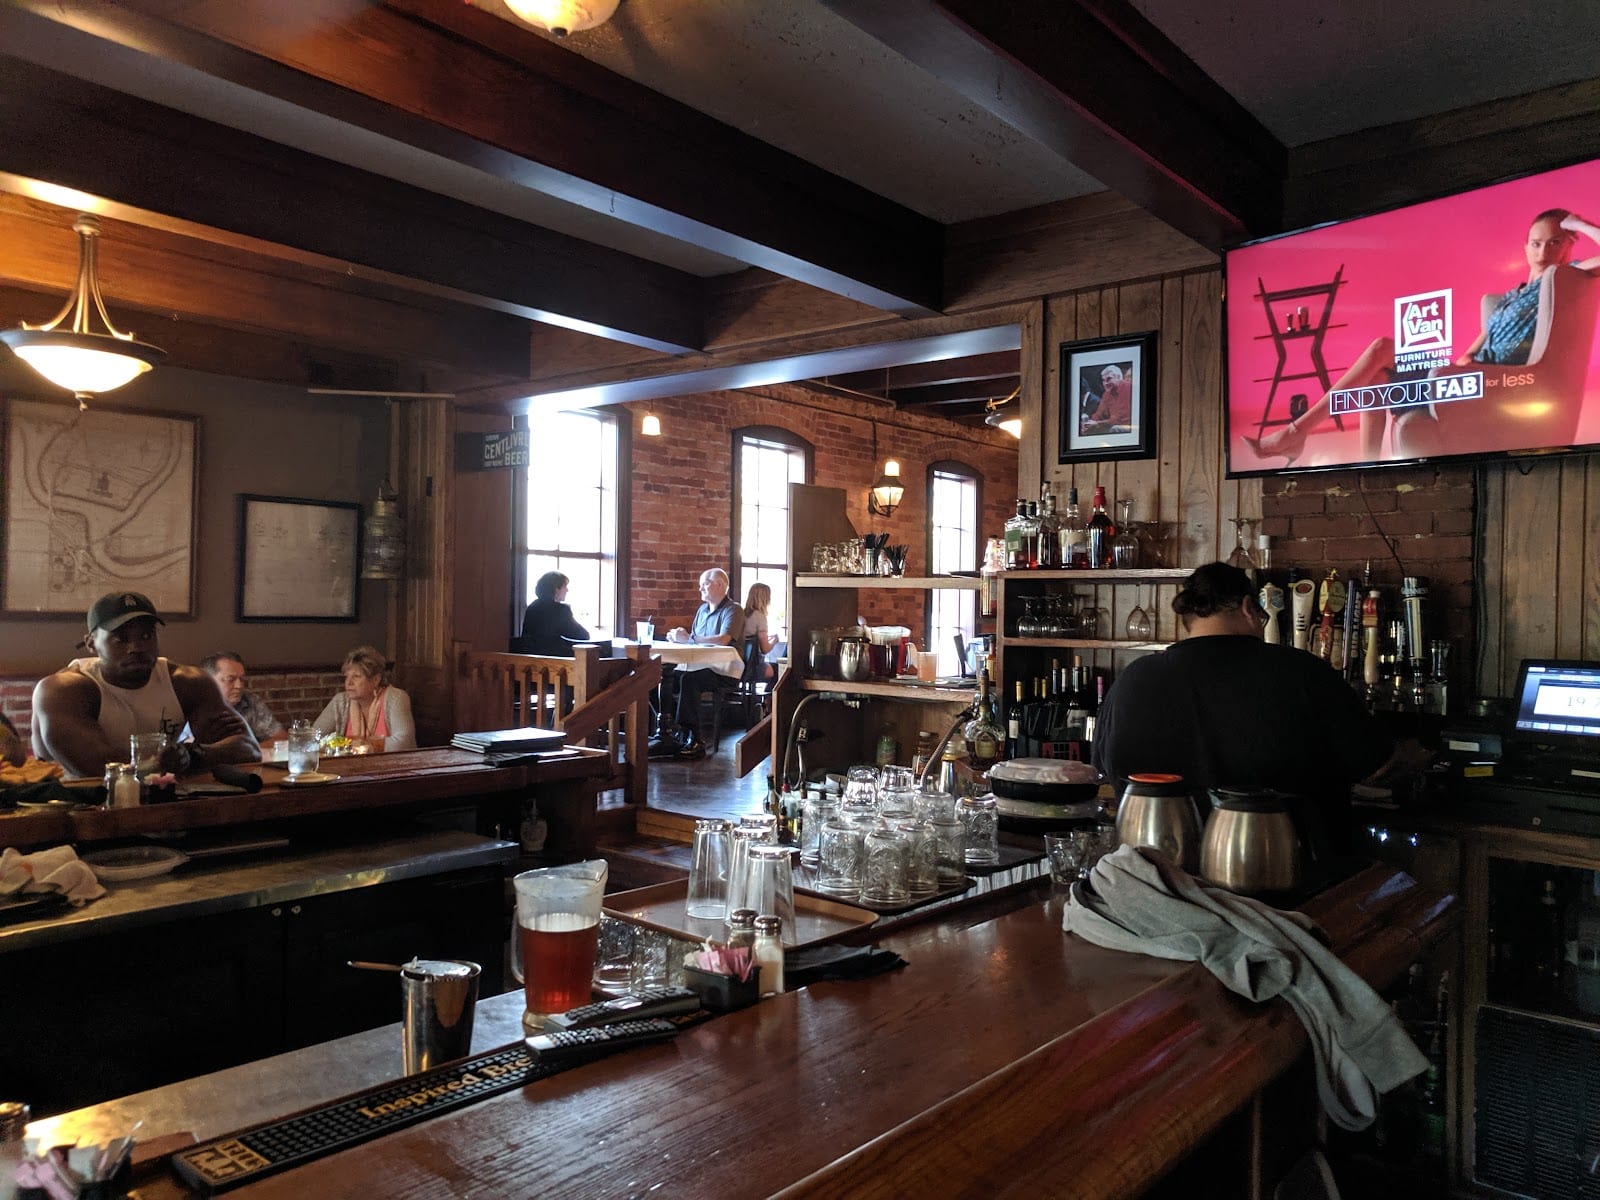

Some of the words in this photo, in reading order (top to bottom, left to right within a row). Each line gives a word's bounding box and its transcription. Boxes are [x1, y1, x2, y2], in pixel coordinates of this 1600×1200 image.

[1409, 301, 1438, 320] Art
[1409, 316, 1443, 335] Van
[1394, 348, 1452, 364] FURNITURE
[1396, 358, 1451, 373] MATTRESS
[1334, 389, 1376, 411] FIND
[1379, 382, 1432, 405] YOUR
[1435, 376, 1478, 399] FAB
[1485, 376, 1499, 387] for
[1502, 371, 1535, 388] less
[504, 451, 528, 465] BEER
[356, 1072, 484, 1119] Inspired
[477, 1056, 533, 1079] Bre
